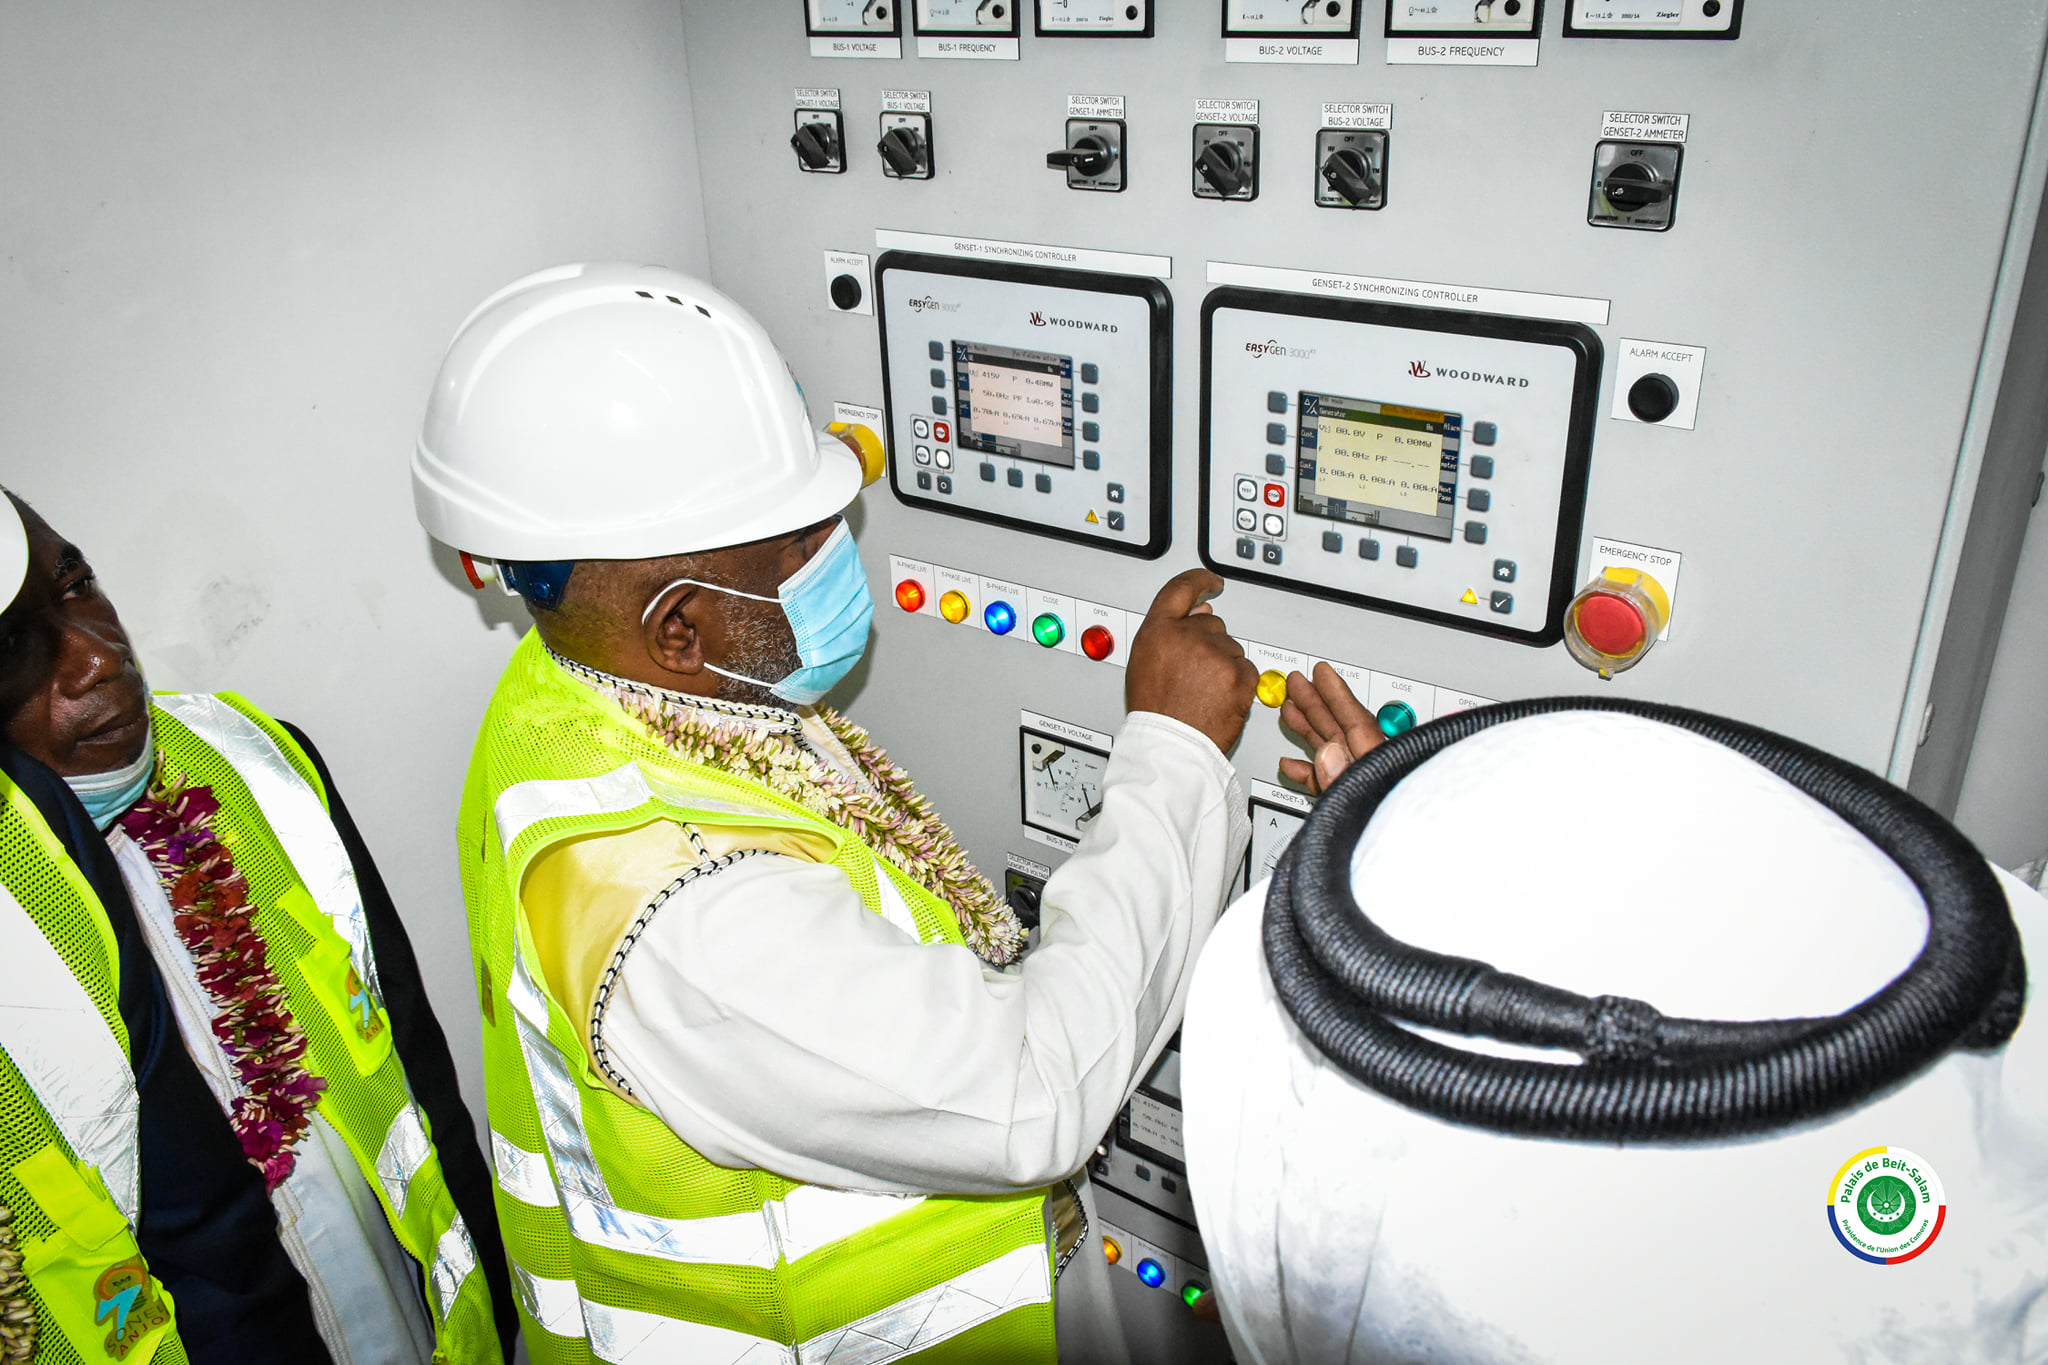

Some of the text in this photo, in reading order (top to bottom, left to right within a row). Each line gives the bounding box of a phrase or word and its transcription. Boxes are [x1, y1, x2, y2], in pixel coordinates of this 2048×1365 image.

[833, 43, 877, 52] BUS-1 VOLTAGE
[938, 43, 996, 53] BUS-1 FREQUENCY
[1259, 46, 1323, 56] BUS-2 VOLTAGE
[1418, 46, 1505, 57] BUS-2 FREQUENCY
[883, 91, 928, 100] SELECTOR SWITCH
[1072, 96, 1120, 105] SELECTOR SWITCH
[903, 102, 925, 110] VOLTAGE
[1069, 107, 1122, 116] GENSET-1 AMMETER
[1197, 100, 1256, 111] SELECTOR SWITCH
[1324, 104, 1389, 114] SELECTOR SWITCH
[1196, 113, 1257, 123] GENSET-2 VOLTAGE
[1328, 117, 1384, 127] BUS-2 VOLTAGE
[1609, 113, 1682, 125] SELECTOR SWITCH
[1603, 126, 1684, 140] GENSET-2 AMMETER
[954, 242, 1076, 262] GENSET-1 SYNCHRONIZING CONTROLLER
[1312, 278, 1478, 303] GENSET-2 SYNCHRONIZING CONTROLLER
[1049, 317, 1118, 333] WOODWARD
[1245, 340, 1286, 357] EASYGEN
[1629, 348, 1693, 362] ALARM ACCEPT
[1436, 367, 1529, 388] WOODWARD
[839, 407, 878, 420] EMERGENCY STOP
[1319, 408, 1346, 418] Generator
[1443, 423, 1460, 432] Alarm
[1336, 427, 1366, 437] 00.0V
[1394, 436, 1432, 448] 0.00MW
[1334, 448, 1369, 460] 00.0Hz
[1375, 455, 1388, 463] PF
[1320, 467, 1438, 493] 0.00kA 0.00kA 0.00kA
[1600, 545, 1672, 566] EMERGENCY STOP
[962, 576, 972, 584] LIVE
[986, 582, 1019, 596] B-PHASE LIVE
[1042, 596, 1059, 605] CLOSE
[1093, 608, 1109, 617] OPEN
[1258, 649, 1298, 664] Y-PHASE LIVE
[1346, 670, 1360, 680] LIVE
[1391, 681, 1412, 693] CLOSE
[1458, 698, 1478, 708] OPEN
[1039, 719, 1093, 742] GENSET-3 VOLTAGE
[1271, 790, 1305, 806] GENSET-3
[1269, 818, 1278, 828] A
[1046, 834, 1078, 850] BUS-3 VOLT
[107, 1305, 165, 1354] SONEL
[120, 1317, 164, 1356] ANJO
